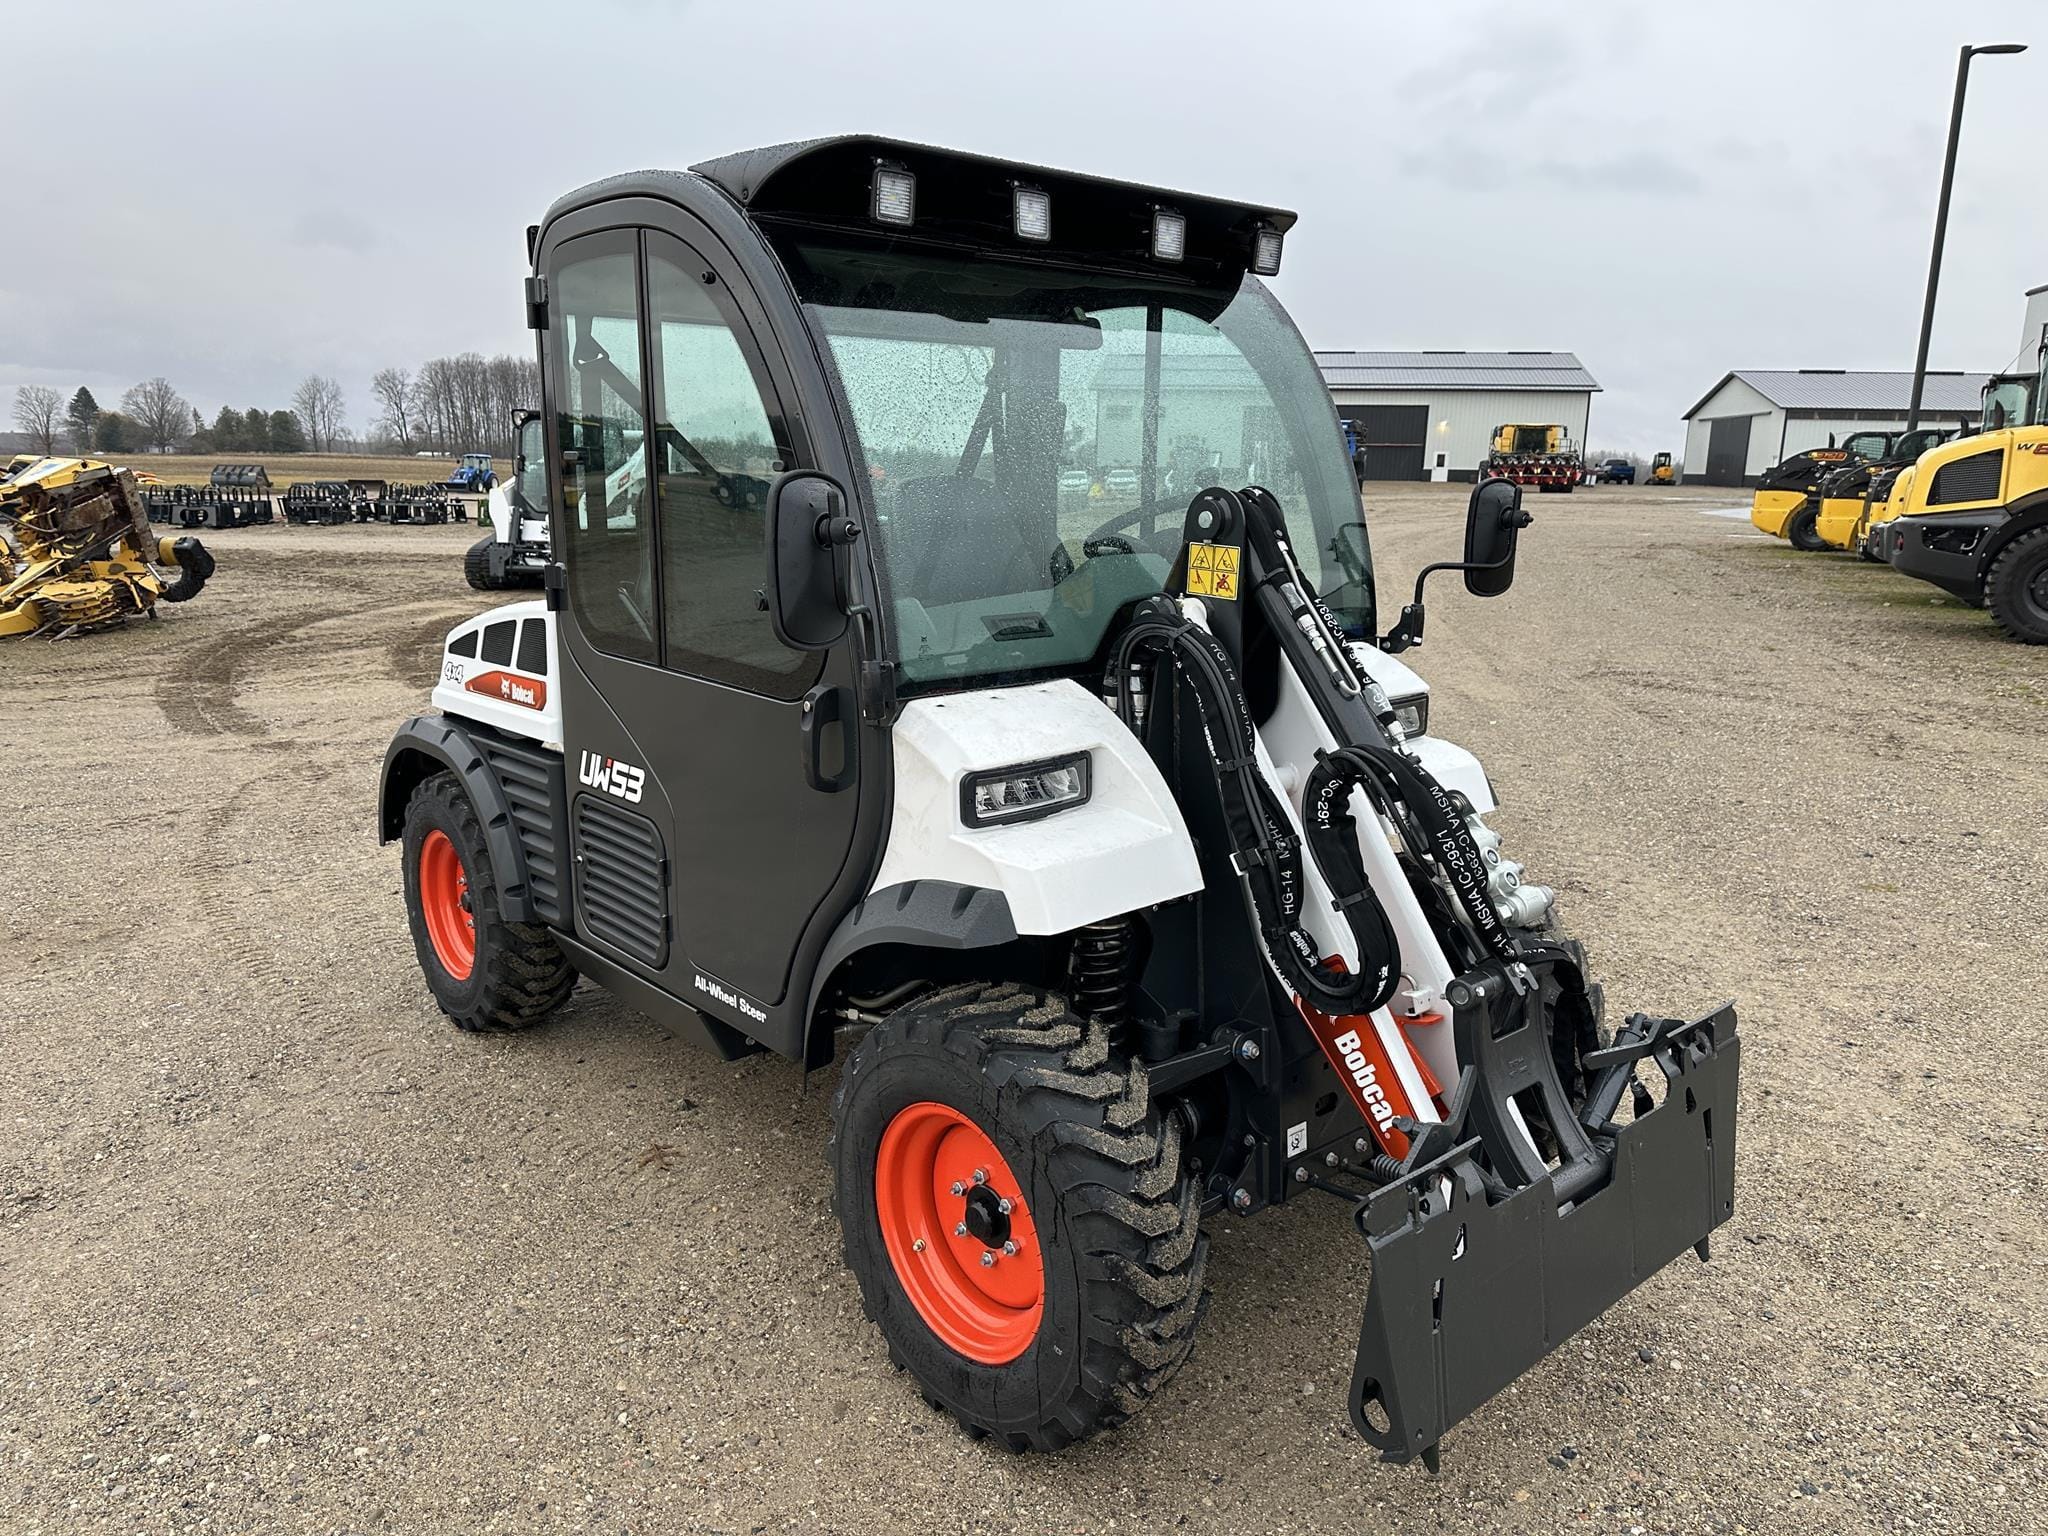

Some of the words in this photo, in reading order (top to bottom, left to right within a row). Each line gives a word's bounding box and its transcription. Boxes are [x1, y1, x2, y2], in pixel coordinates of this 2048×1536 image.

[444, 661, 464, 684] 4x4
[511, 682, 535, 705] Bobcat
[579, 750, 645, 804] UW53
[1429, 785, 1461, 831] MSHA
[1436, 829, 1475, 889] IC-293/1
[1281, 869, 1295, 915] HG-14
[1468, 887, 1496, 930] MSHA
[1290, 930, 1312, 957] Bobca
[694, 974, 737, 1008] All-Wheel
[739, 997, 767, 1023] Steer
[1333, 1029, 1399, 1133] Bobcat
